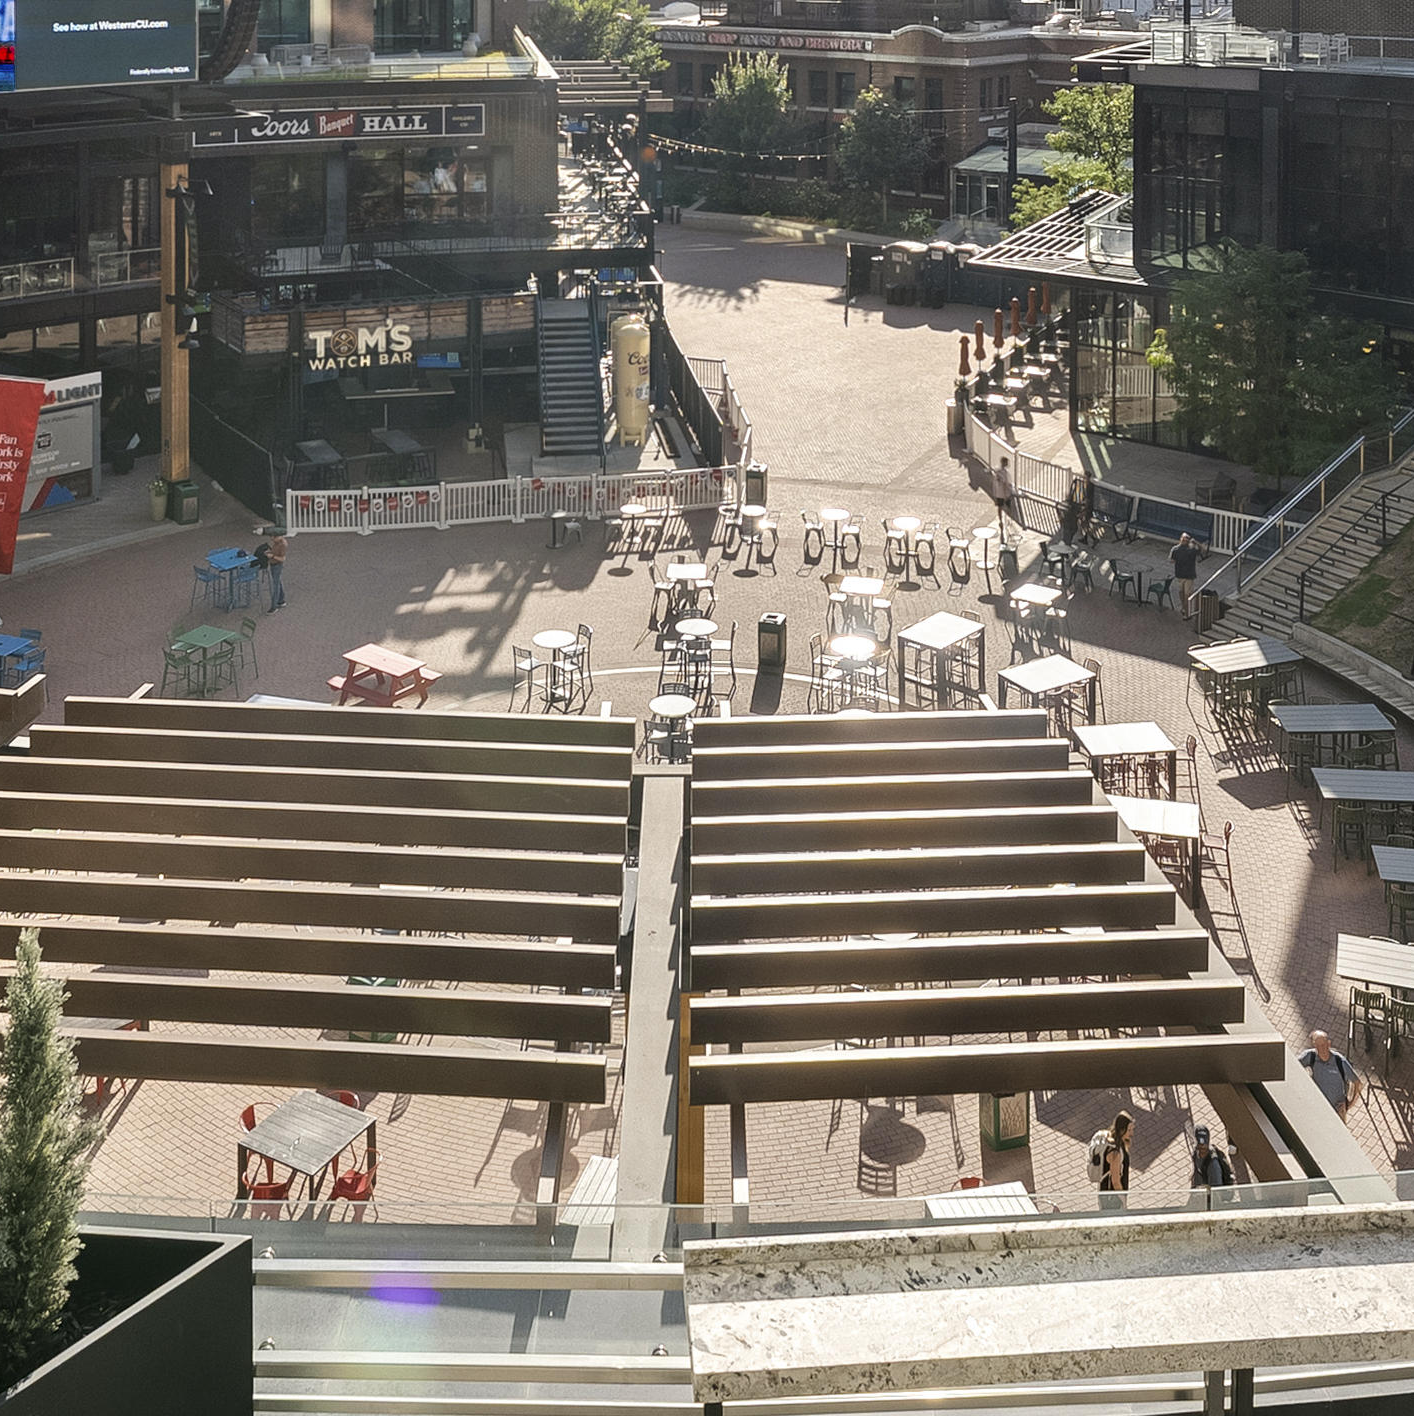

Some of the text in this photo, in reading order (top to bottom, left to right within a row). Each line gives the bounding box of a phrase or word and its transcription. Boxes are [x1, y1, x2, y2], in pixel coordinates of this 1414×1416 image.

[53, 19, 169, 32] See how at WesterraCU.com
[778, 35, 804, 48] AND
[251, 113, 428, 137] Coors Banquet HALL
[309, 351, 414, 371] WATCH BAR
[57, 382, 102, 403] LIGHT
[14, 447, 24, 458] is
